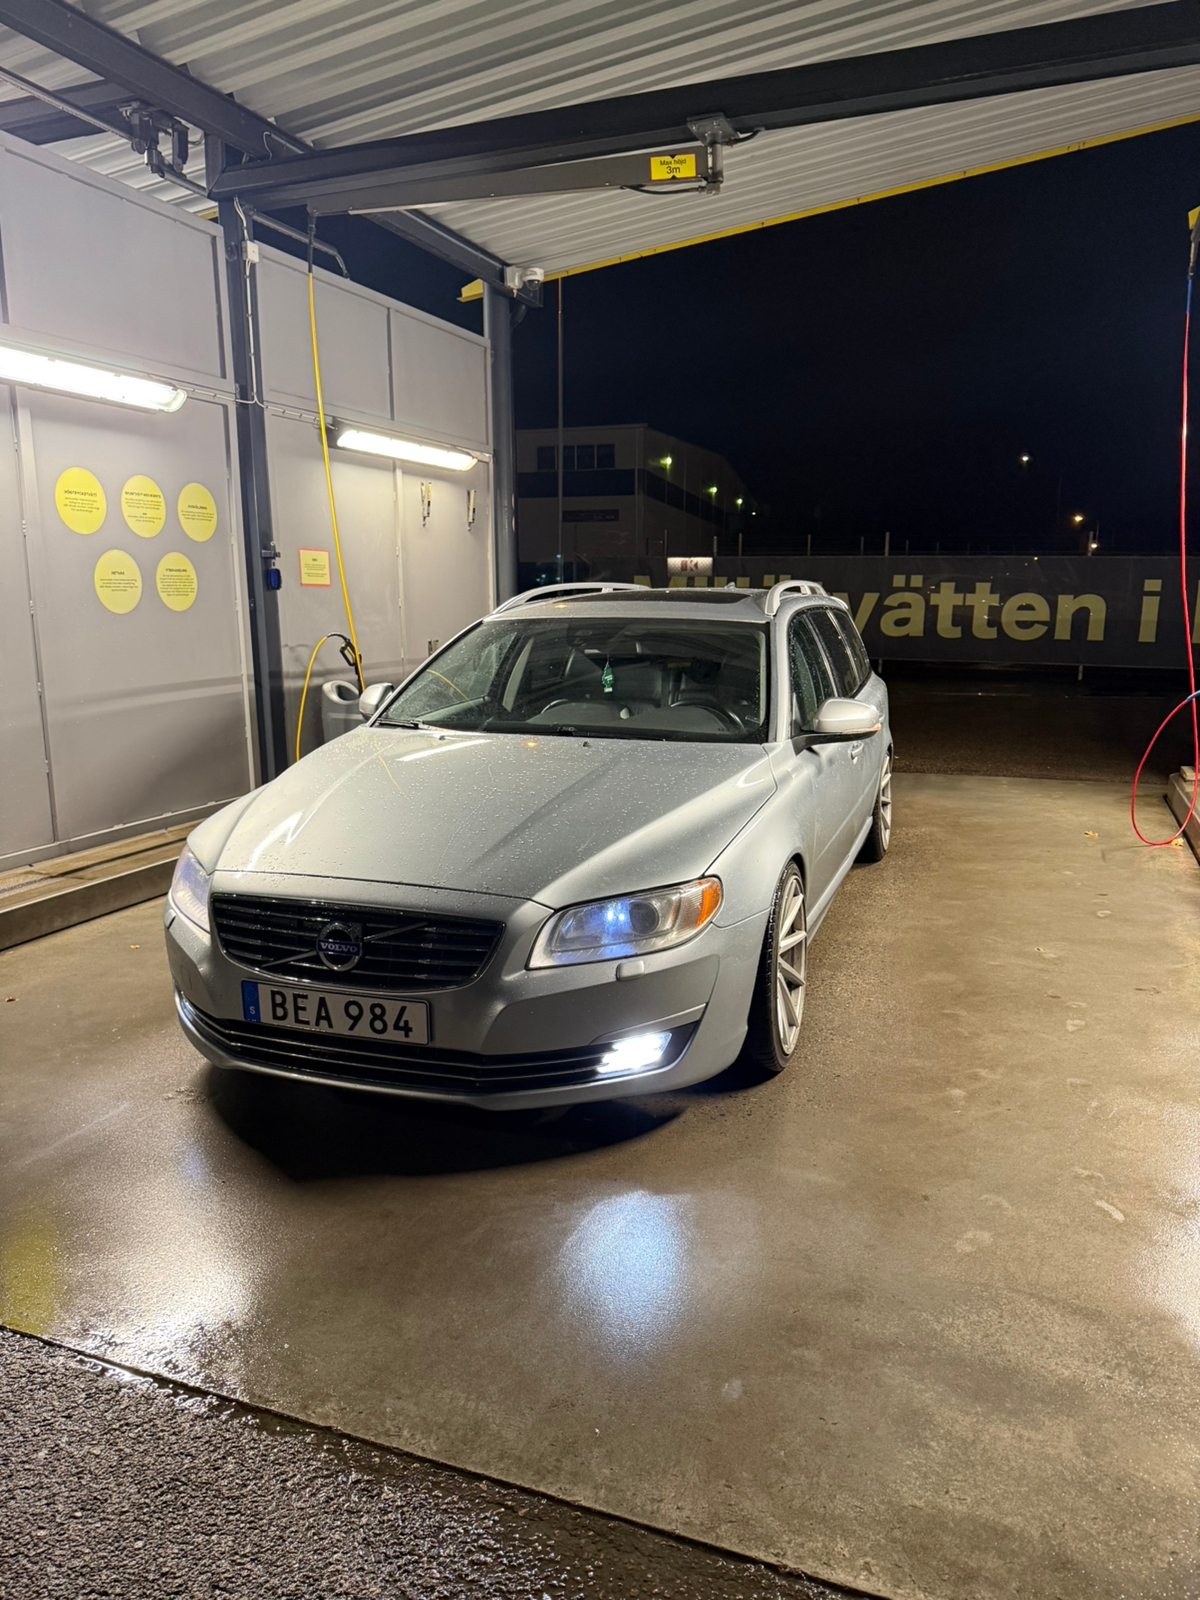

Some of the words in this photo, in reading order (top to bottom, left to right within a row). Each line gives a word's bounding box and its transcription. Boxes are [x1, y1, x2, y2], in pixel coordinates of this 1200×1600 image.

[666, 166, 680, 174] 3m
[633, 574, 1107, 642] vätten
[1138, 579, 1162, 643] i
[320, 942, 358, 952] VOLVO
[249, 1005, 256, 1015] S
[270, 989, 334, 1029] BEA
[344, 1000, 413, 1039] 984
